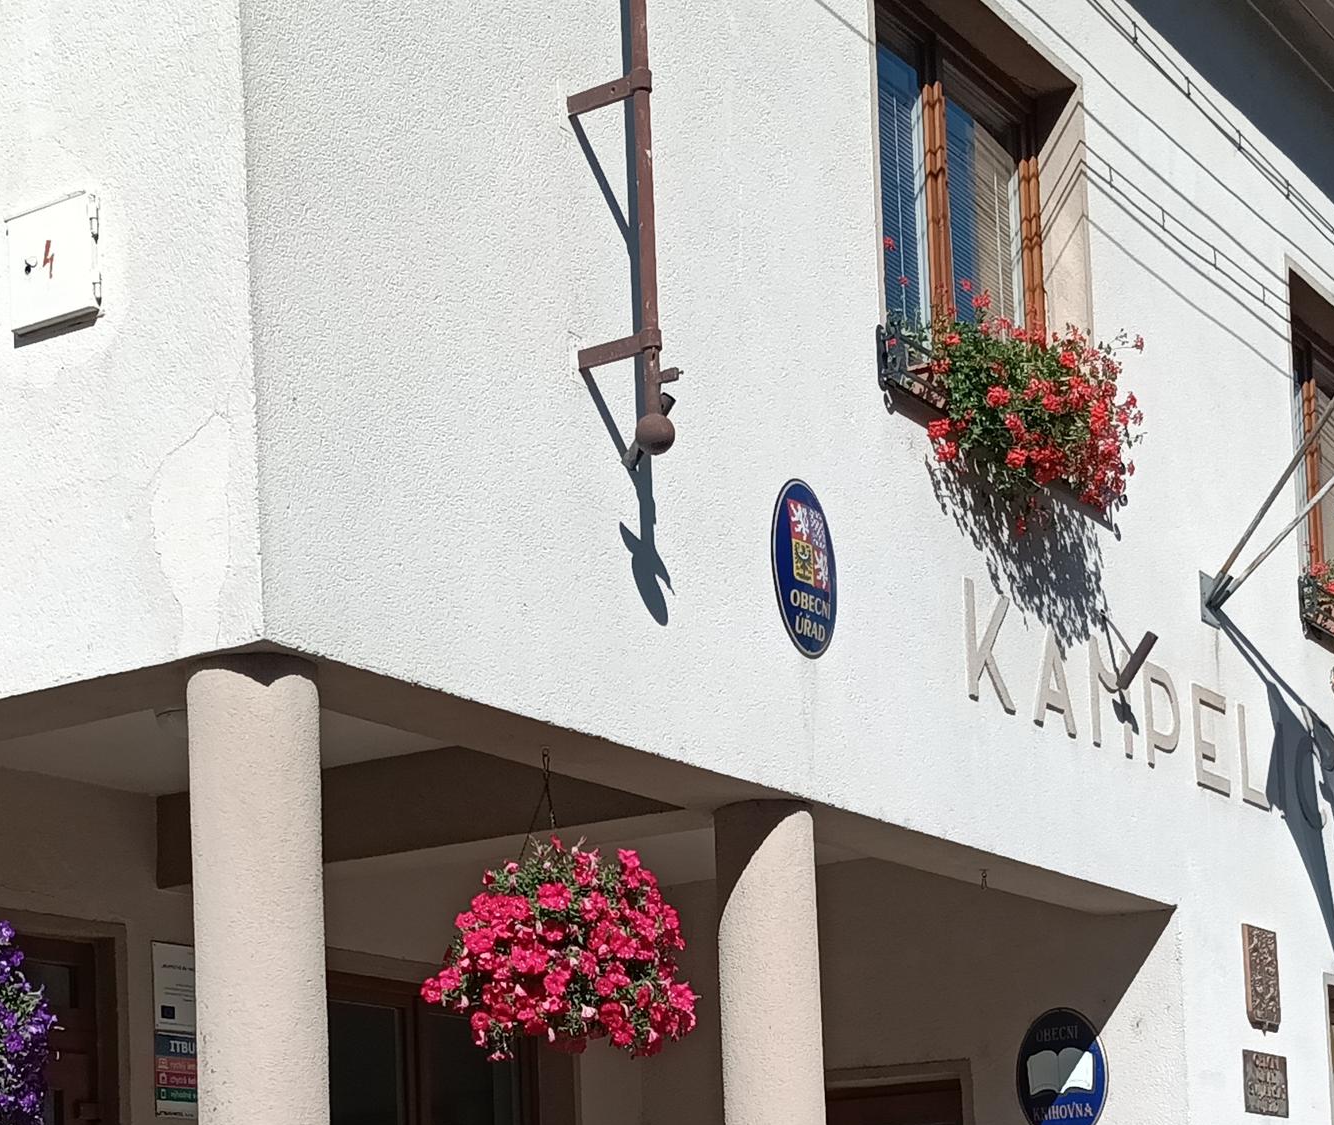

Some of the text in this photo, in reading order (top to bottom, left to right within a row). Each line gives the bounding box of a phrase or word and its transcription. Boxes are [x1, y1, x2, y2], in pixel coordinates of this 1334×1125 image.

[790, 589, 831, 620] OBECNÍ
[795, 611, 826, 642] ÚŘAD
[1036, 1025, 1079, 1042] OBECNÍ
[1033, 1101, 1094, 1121] KNIHOVNA
